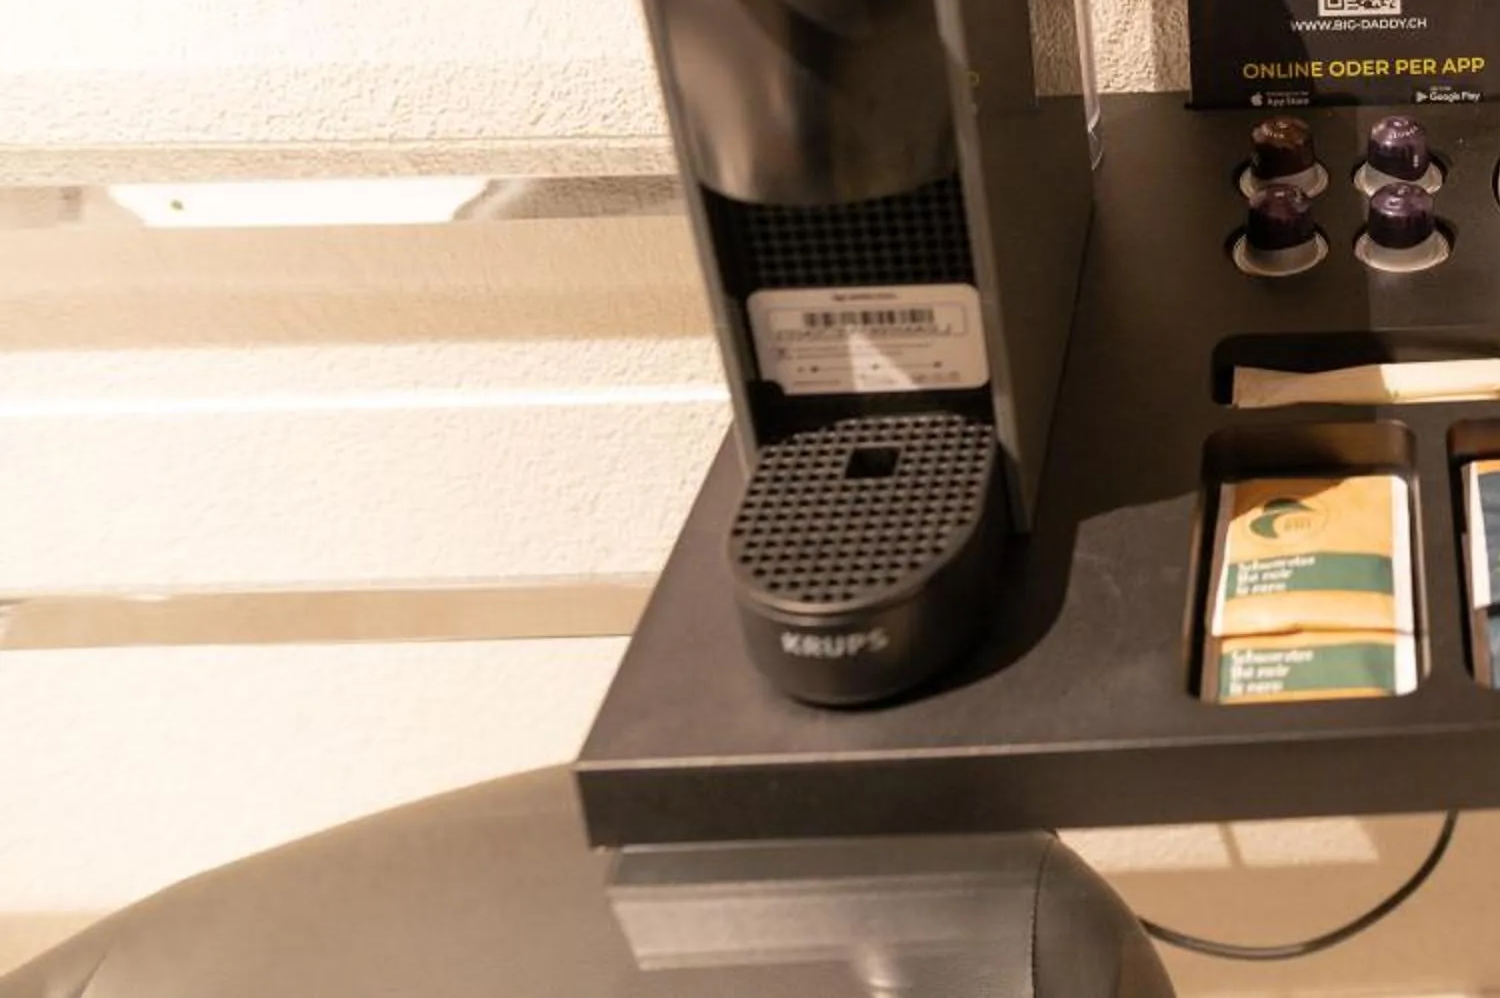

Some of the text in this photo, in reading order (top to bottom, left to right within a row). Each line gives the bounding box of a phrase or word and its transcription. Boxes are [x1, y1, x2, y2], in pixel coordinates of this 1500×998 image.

[1290, 17, 1428, 31] WWW.BIG-DADDY.CH
[1242, 57, 1485, 79] ONLINE ODER PER APP
[1429, 91, 1481, 103] Google Play
[780, 629, 890, 658] KRUPS
